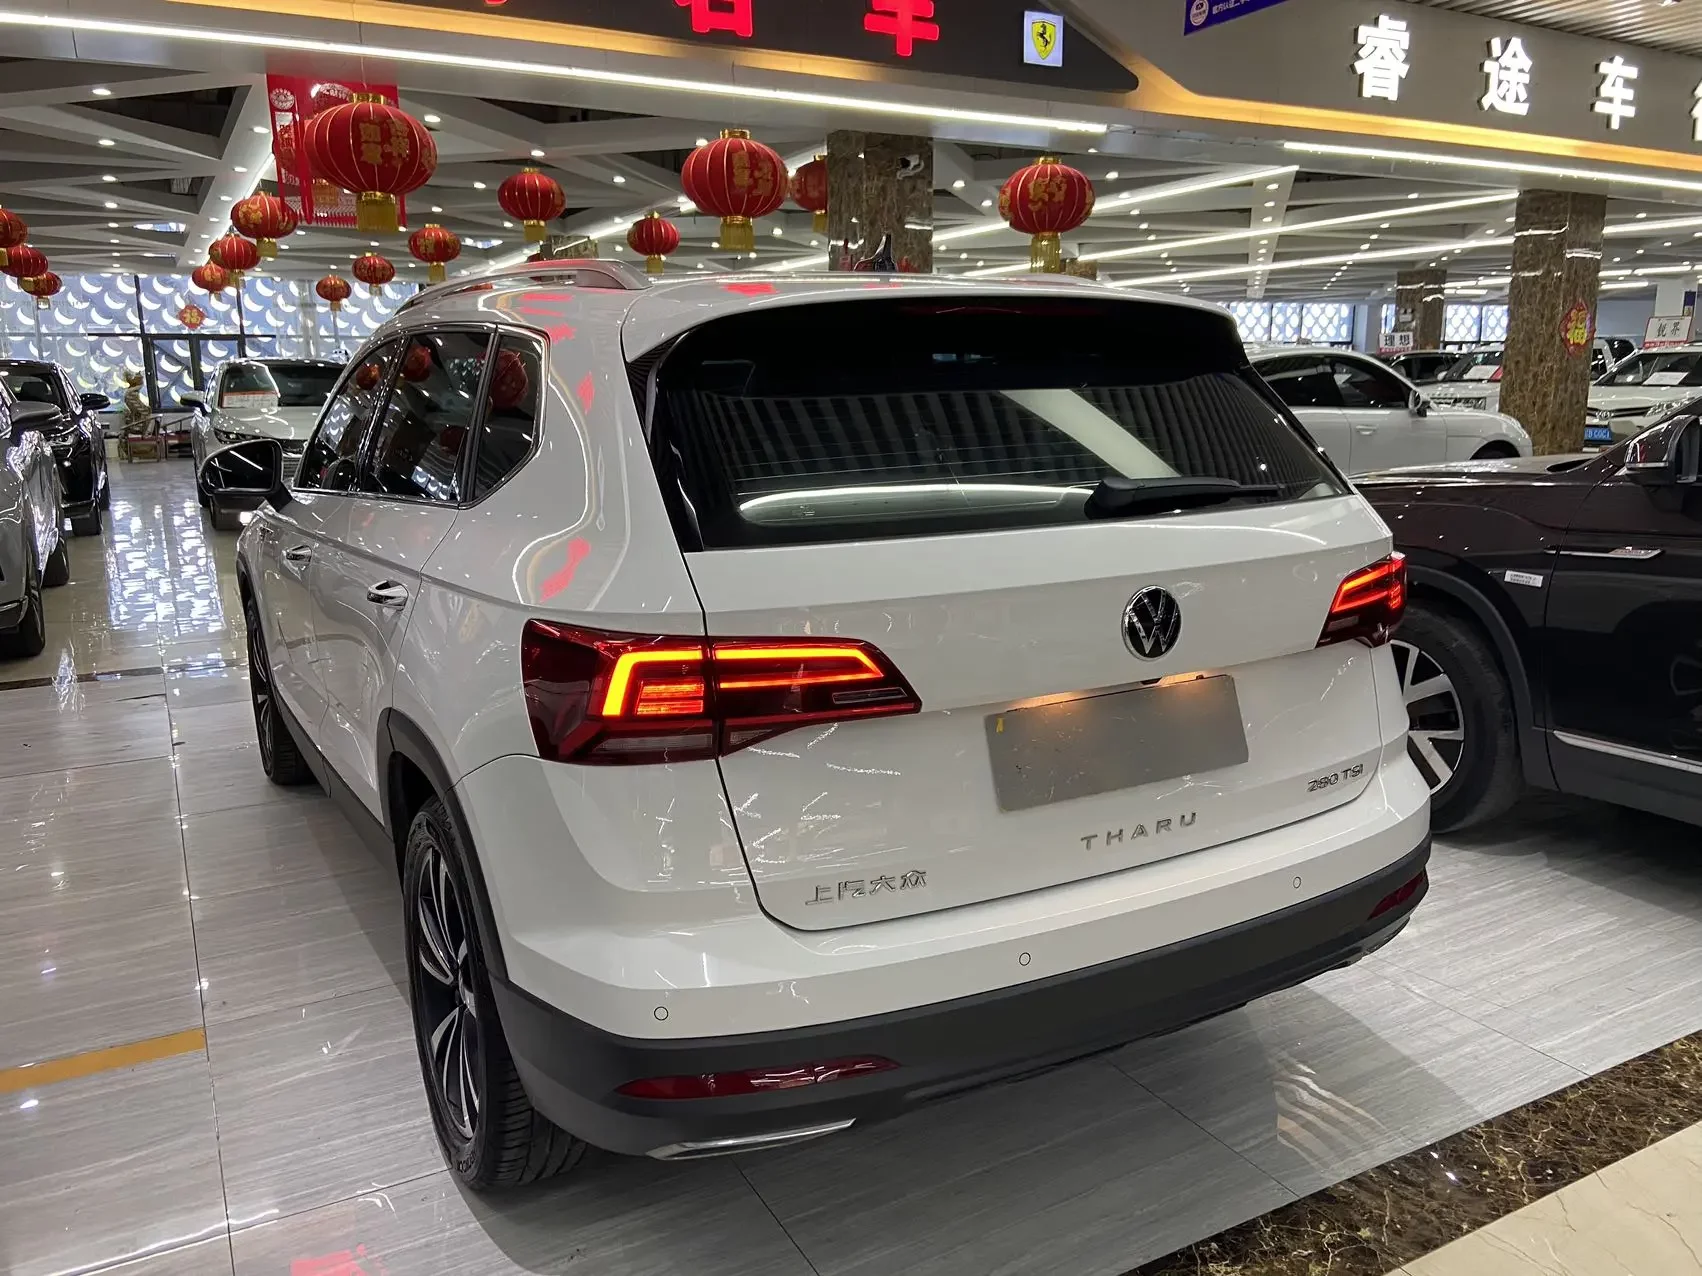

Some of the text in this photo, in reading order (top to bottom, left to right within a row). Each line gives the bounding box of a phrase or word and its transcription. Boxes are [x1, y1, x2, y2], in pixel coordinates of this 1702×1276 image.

[1353, 15, 1702, 141] 睿途车
[1384, 333, 1410, 347] 理想
[1305, 763, 1365, 793] 280 TSI
[1080, 811, 1198, 851] THARU
[804, 869, 927, 906] 上汽大众
